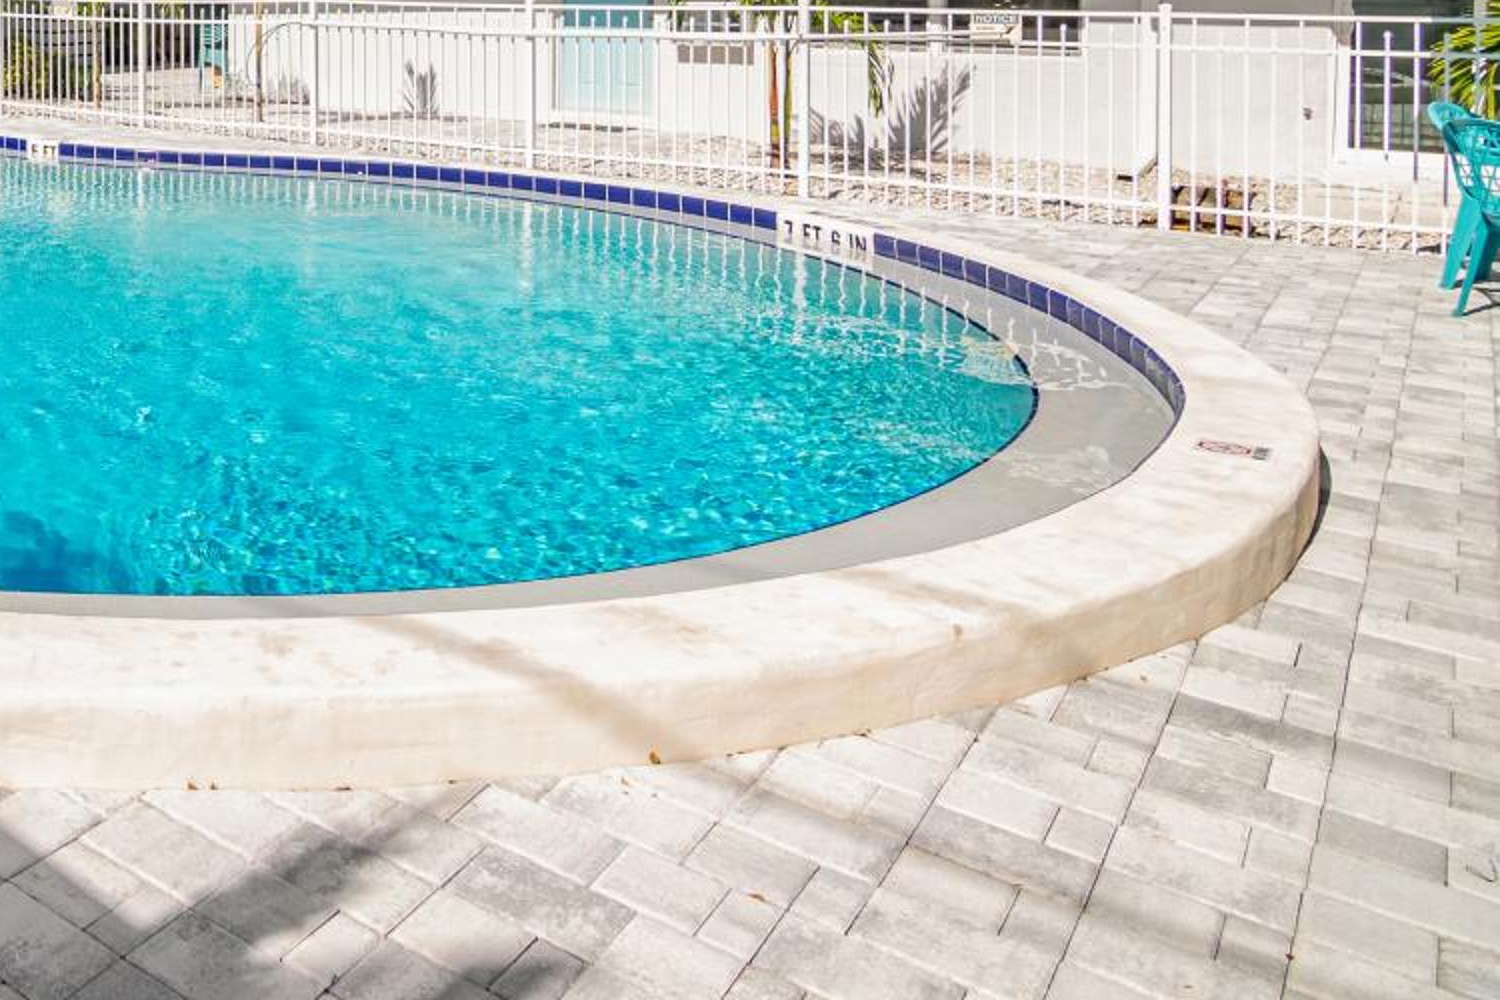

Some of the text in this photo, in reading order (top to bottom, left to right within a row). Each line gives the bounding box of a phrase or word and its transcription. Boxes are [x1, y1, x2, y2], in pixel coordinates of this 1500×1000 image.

[784, 220, 793, 237] 7
[803, 223, 822, 241] FT
[849, 233, 867, 251] IN
